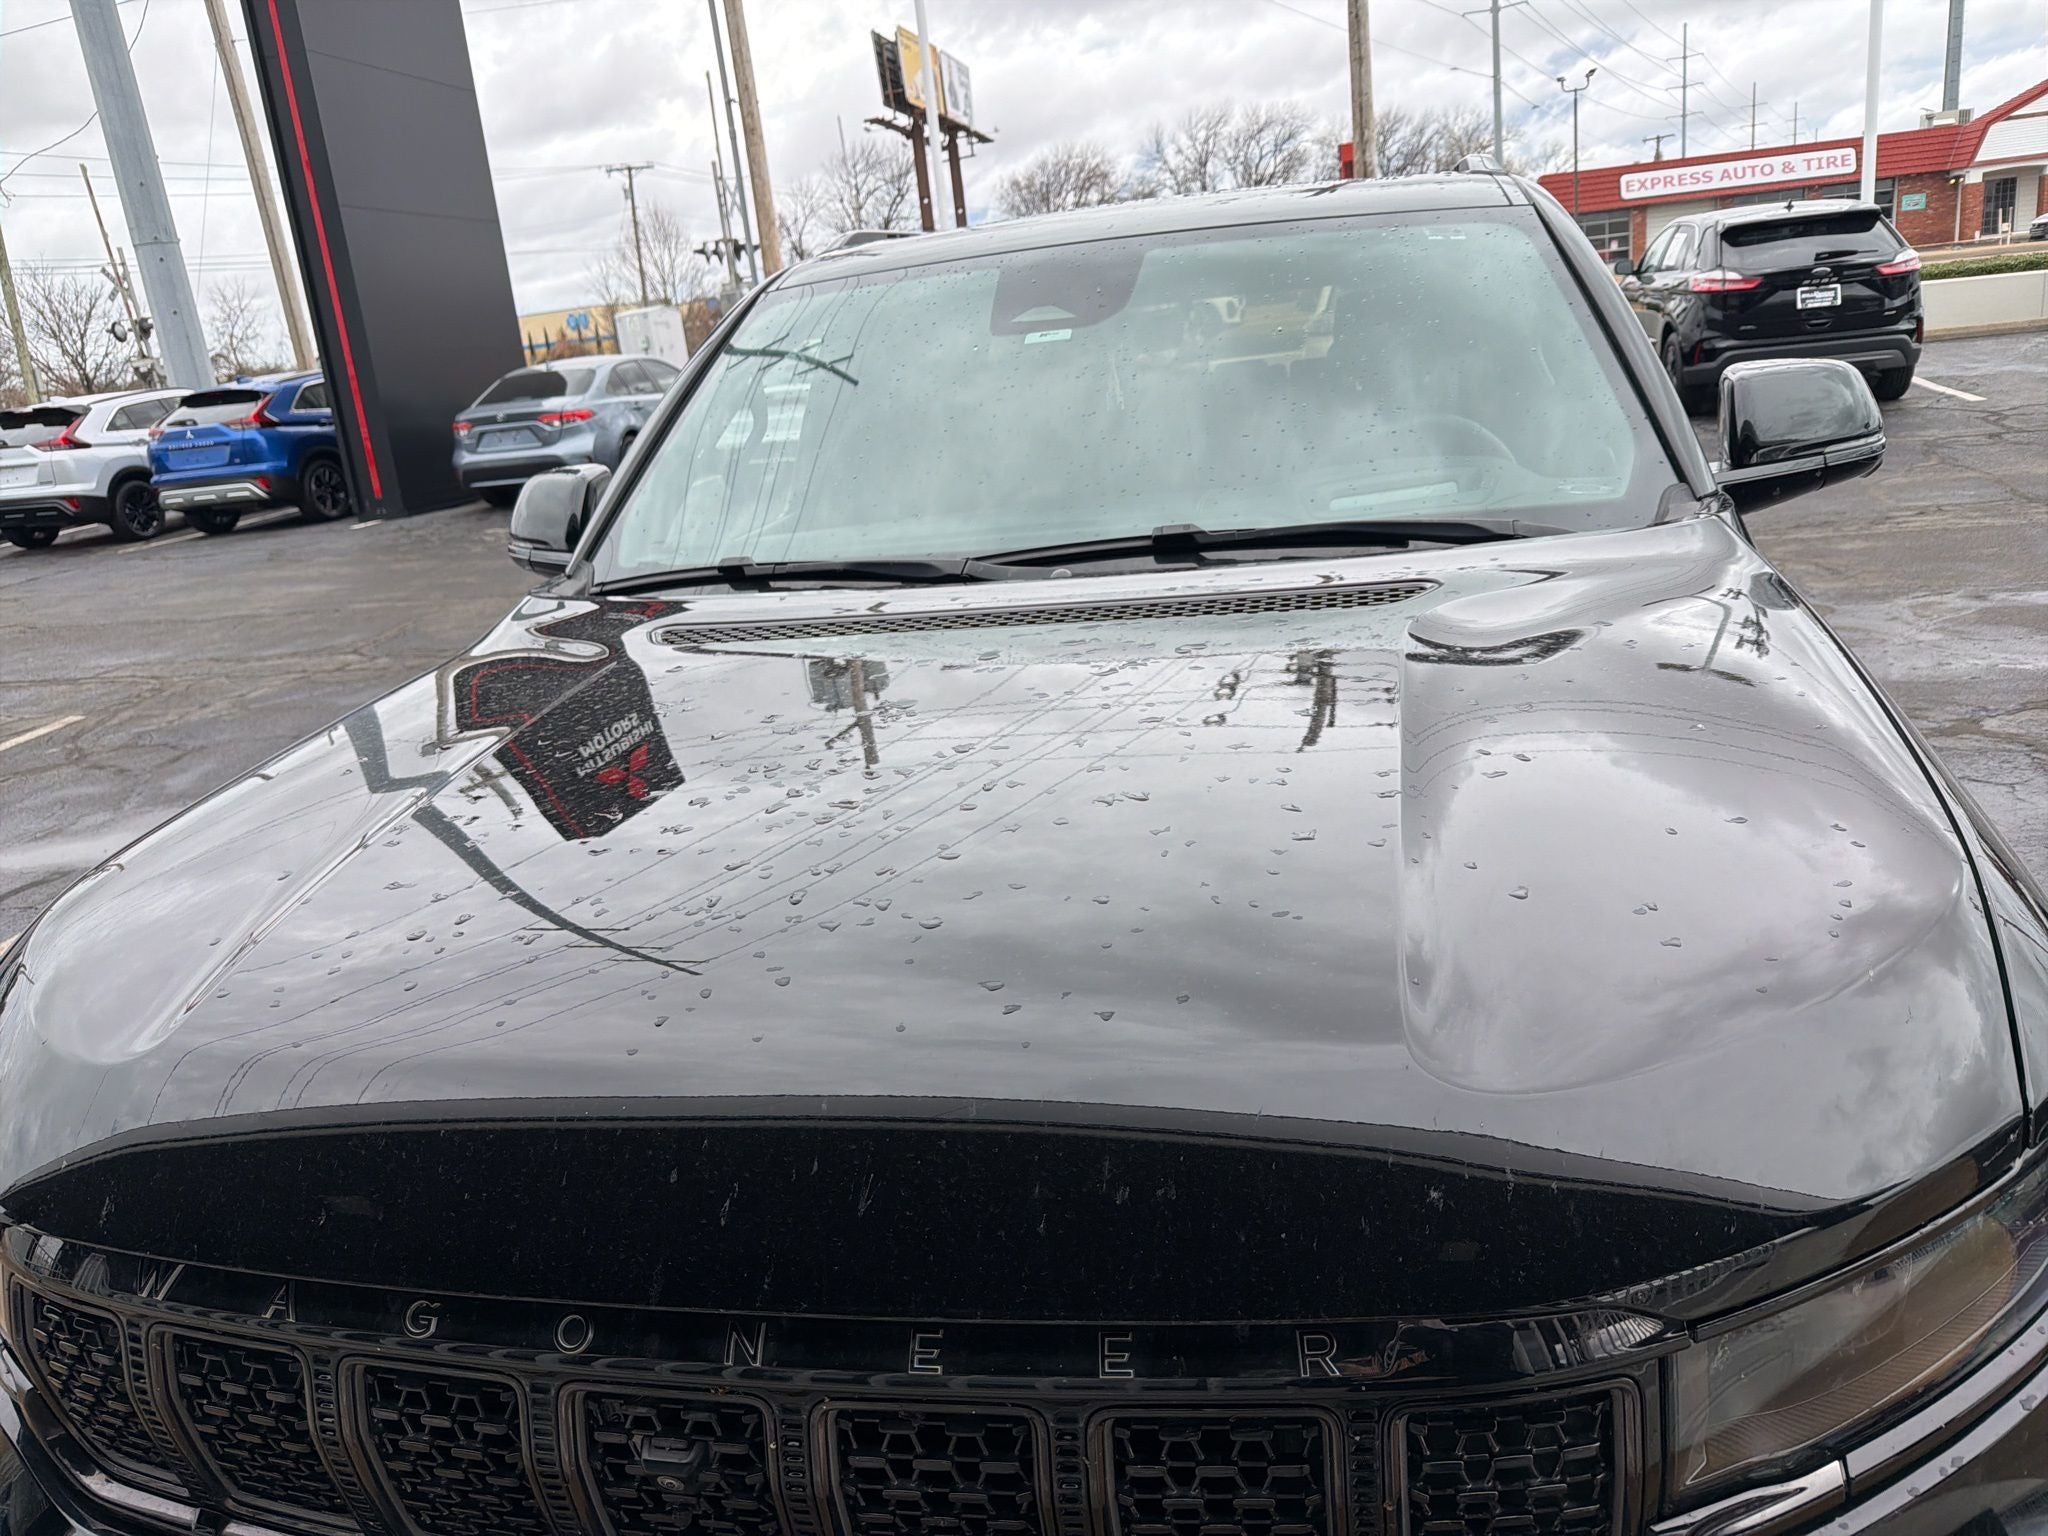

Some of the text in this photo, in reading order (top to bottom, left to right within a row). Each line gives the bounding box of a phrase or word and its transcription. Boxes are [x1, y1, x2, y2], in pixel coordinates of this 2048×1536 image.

[1625, 153, 1852, 193] EXPRESS AUTO & TIRE
[136, 1256, 1342, 1379] WAGONEER
